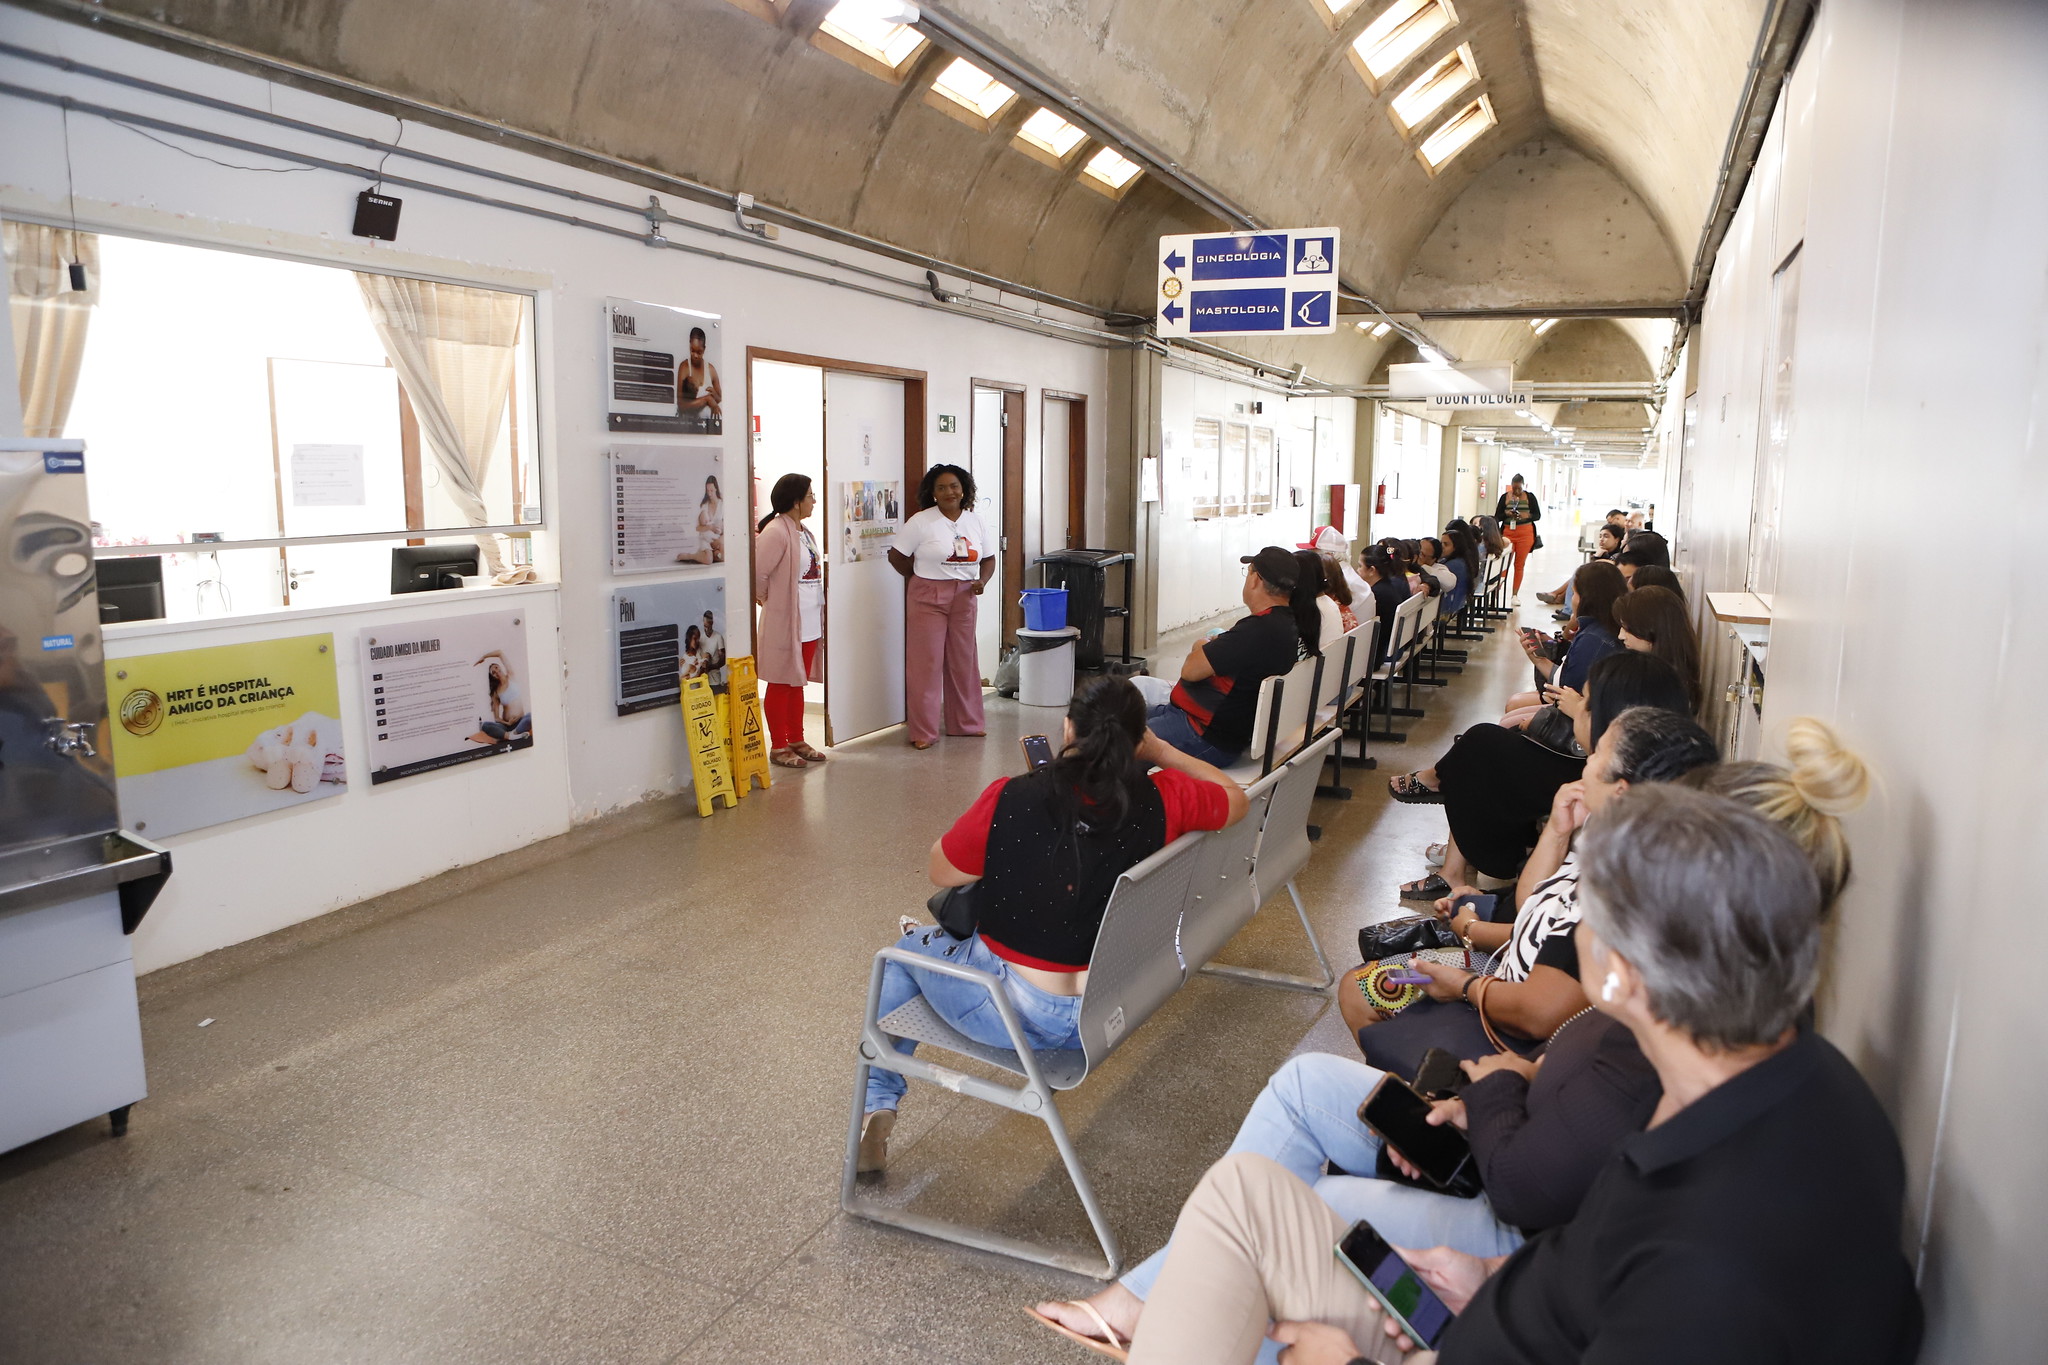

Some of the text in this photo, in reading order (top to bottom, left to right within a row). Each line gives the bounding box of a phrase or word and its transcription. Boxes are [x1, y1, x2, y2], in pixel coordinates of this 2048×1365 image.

[1196, 252, 1281, 264] GINECOLOGIA
[1196, 305, 1280, 316] MASTOLOGIA
[612, 313, 637, 336] NBCAL
[1436, 394, 1526, 405] ODONTOLOGIA
[620, 601, 635, 623] PRN
[43, 638, 73, 649] NATURAL
[370, 645, 394, 661] CUIDADO
[394, 642, 412, 657] AMIGO
[412, 641, 420, 655] DA
[420, 638, 441, 654] MULHER
[166, 688, 194, 703] HRT
[197, 684, 206, 698] É
[209, 677, 272, 696] HOSPITAL
[168, 699, 213, 716] AMIGO
[217, 694, 237, 709] DA
[239, 686, 295, 704] CRIANÇA
[740, 691, 757, 702] CUIDADO
[691, 700, 712, 711] CUIDADO
